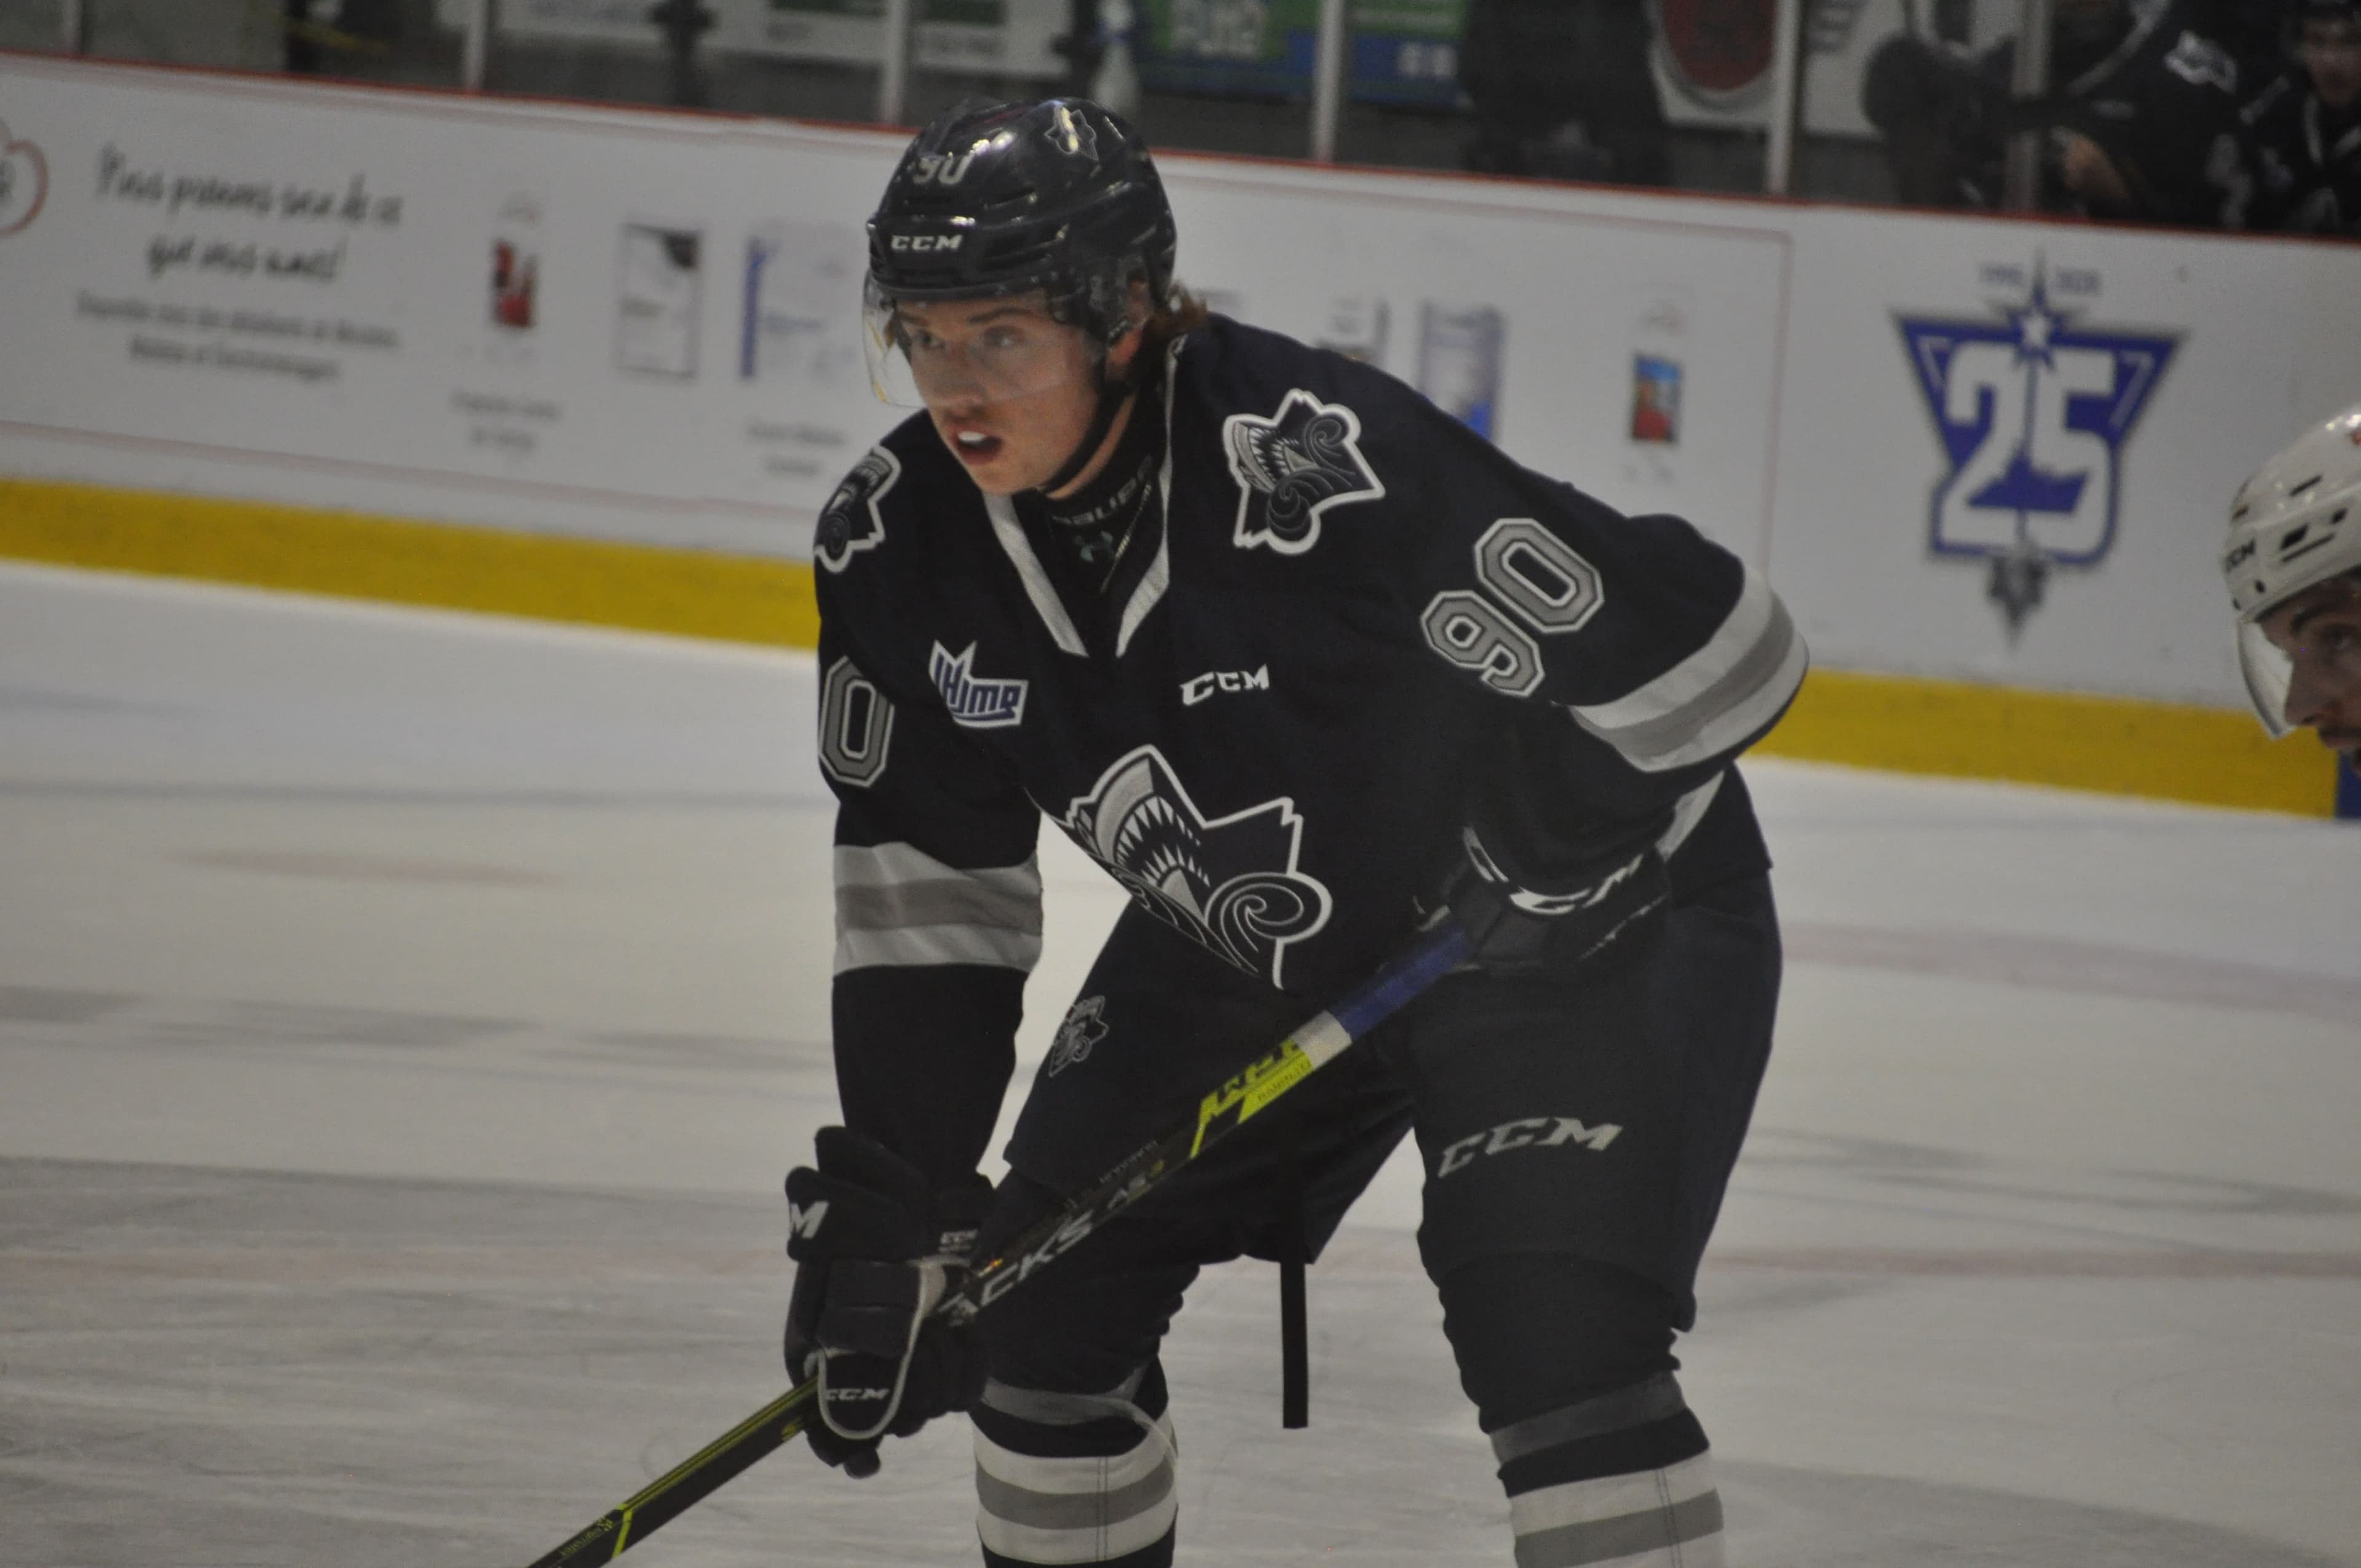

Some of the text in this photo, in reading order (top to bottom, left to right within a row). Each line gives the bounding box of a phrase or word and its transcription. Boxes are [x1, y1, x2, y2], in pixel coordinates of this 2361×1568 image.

[890, 234, 964, 251] CCM
[1937, 338, 2119, 558] 25
[1420, 518, 1605, 697] 90
[818, 655, 895, 788] 0
[1180, 663, 1270, 706] CCM
[1438, 1116, 1624, 1179] CCM
